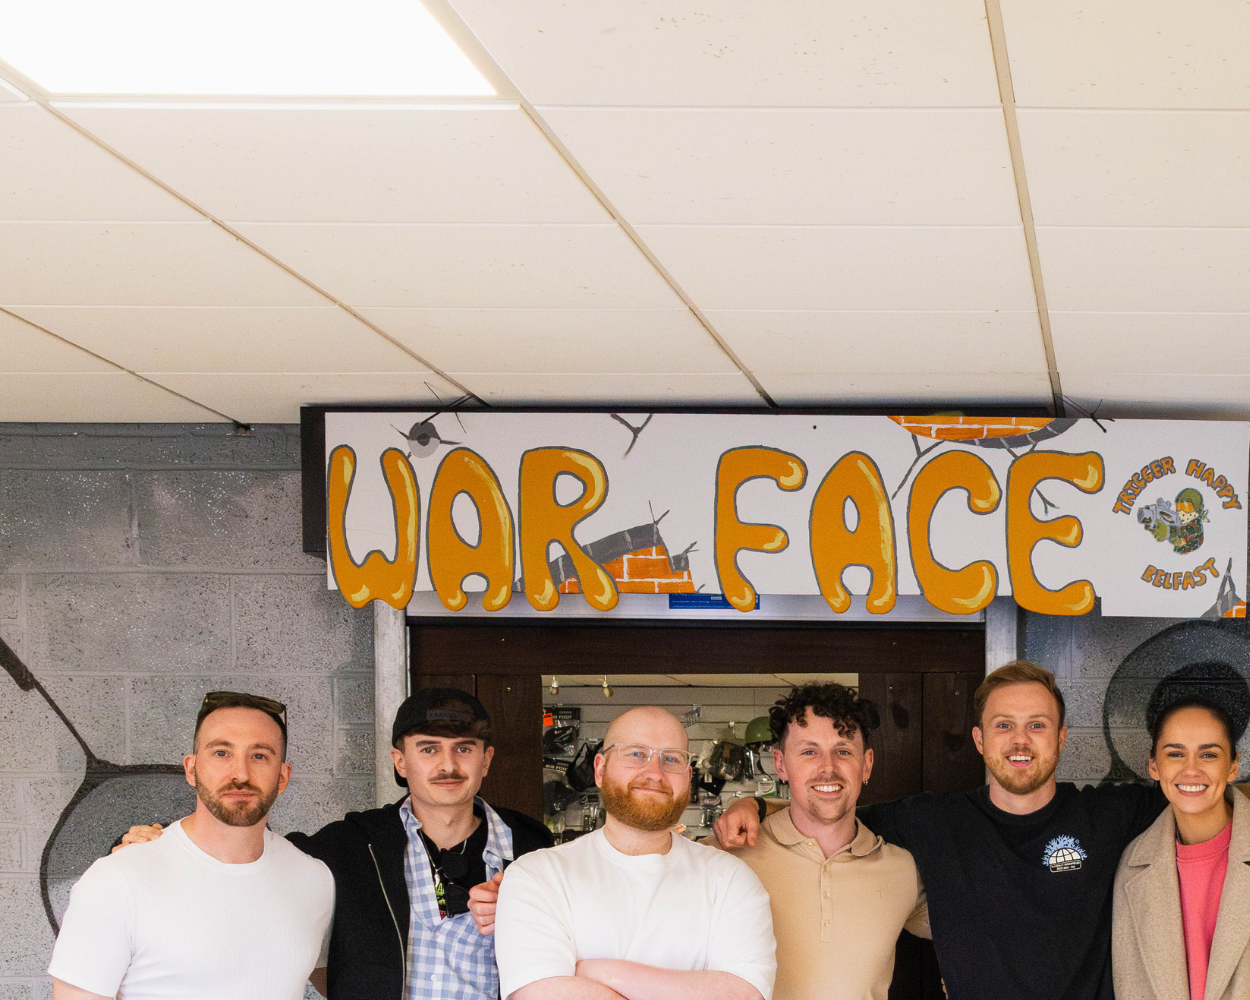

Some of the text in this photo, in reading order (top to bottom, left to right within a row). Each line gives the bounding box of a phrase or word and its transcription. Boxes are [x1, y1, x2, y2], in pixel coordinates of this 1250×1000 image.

[1112, 456, 1242, 515] TRIGGER HAPPY
[328, 444, 1105, 616] WAR FACE
[1141, 557, 1219, 590] BELFAST
